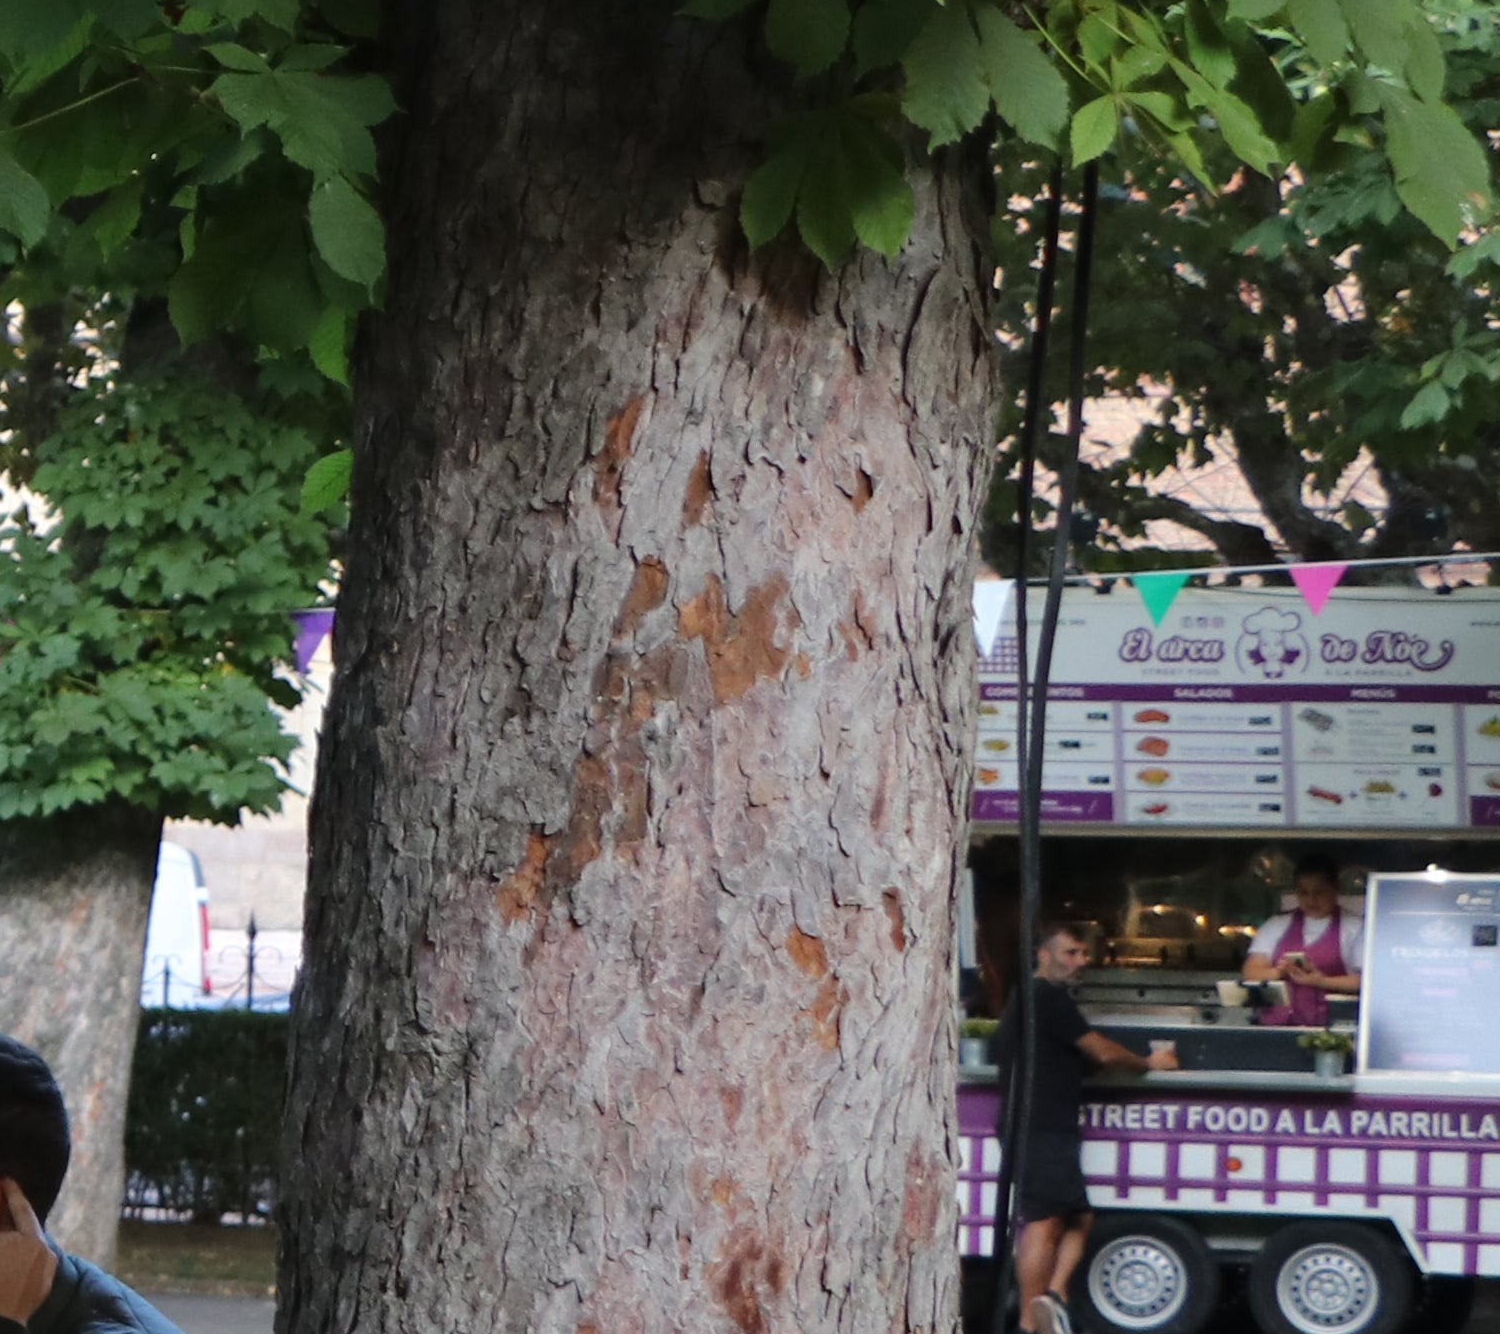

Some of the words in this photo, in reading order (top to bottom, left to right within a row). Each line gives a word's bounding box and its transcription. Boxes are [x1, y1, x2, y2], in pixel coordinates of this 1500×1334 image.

[1119, 627, 1151, 663] El
[1156, 635, 1226, 663] arca
[1320, 633, 1357, 663] de
[1173, 687, 1234, 698] SALADOS
[1186, 1105, 1270, 1133] FOOD
[1274, 1108, 1297, 1134] A
[1303, 1110, 1343, 1136] LA
[1349, 1110, 1500, 1141] PARRILLA
